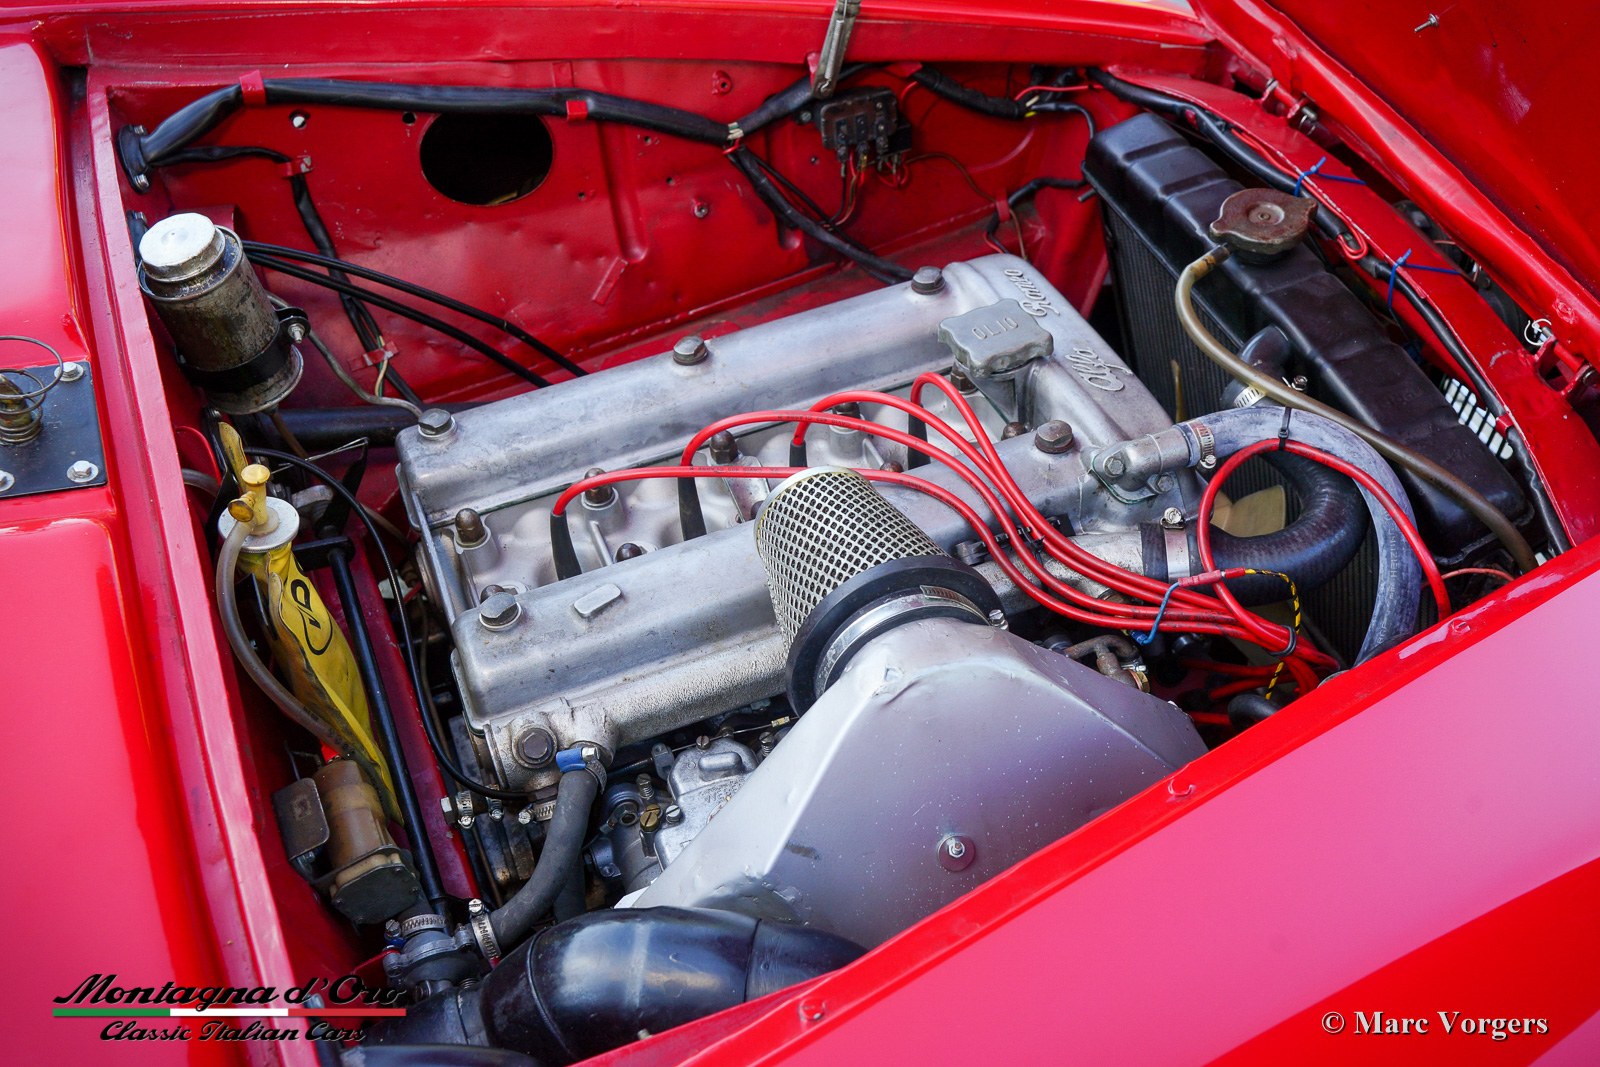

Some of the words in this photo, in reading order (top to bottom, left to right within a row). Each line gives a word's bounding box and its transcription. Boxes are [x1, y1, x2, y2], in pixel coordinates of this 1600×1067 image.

[1003, 269, 1061, 317] Romeo
[971, 316, 1019, 340] OLIO
[1065, 347, 1133, 392] Alfa
